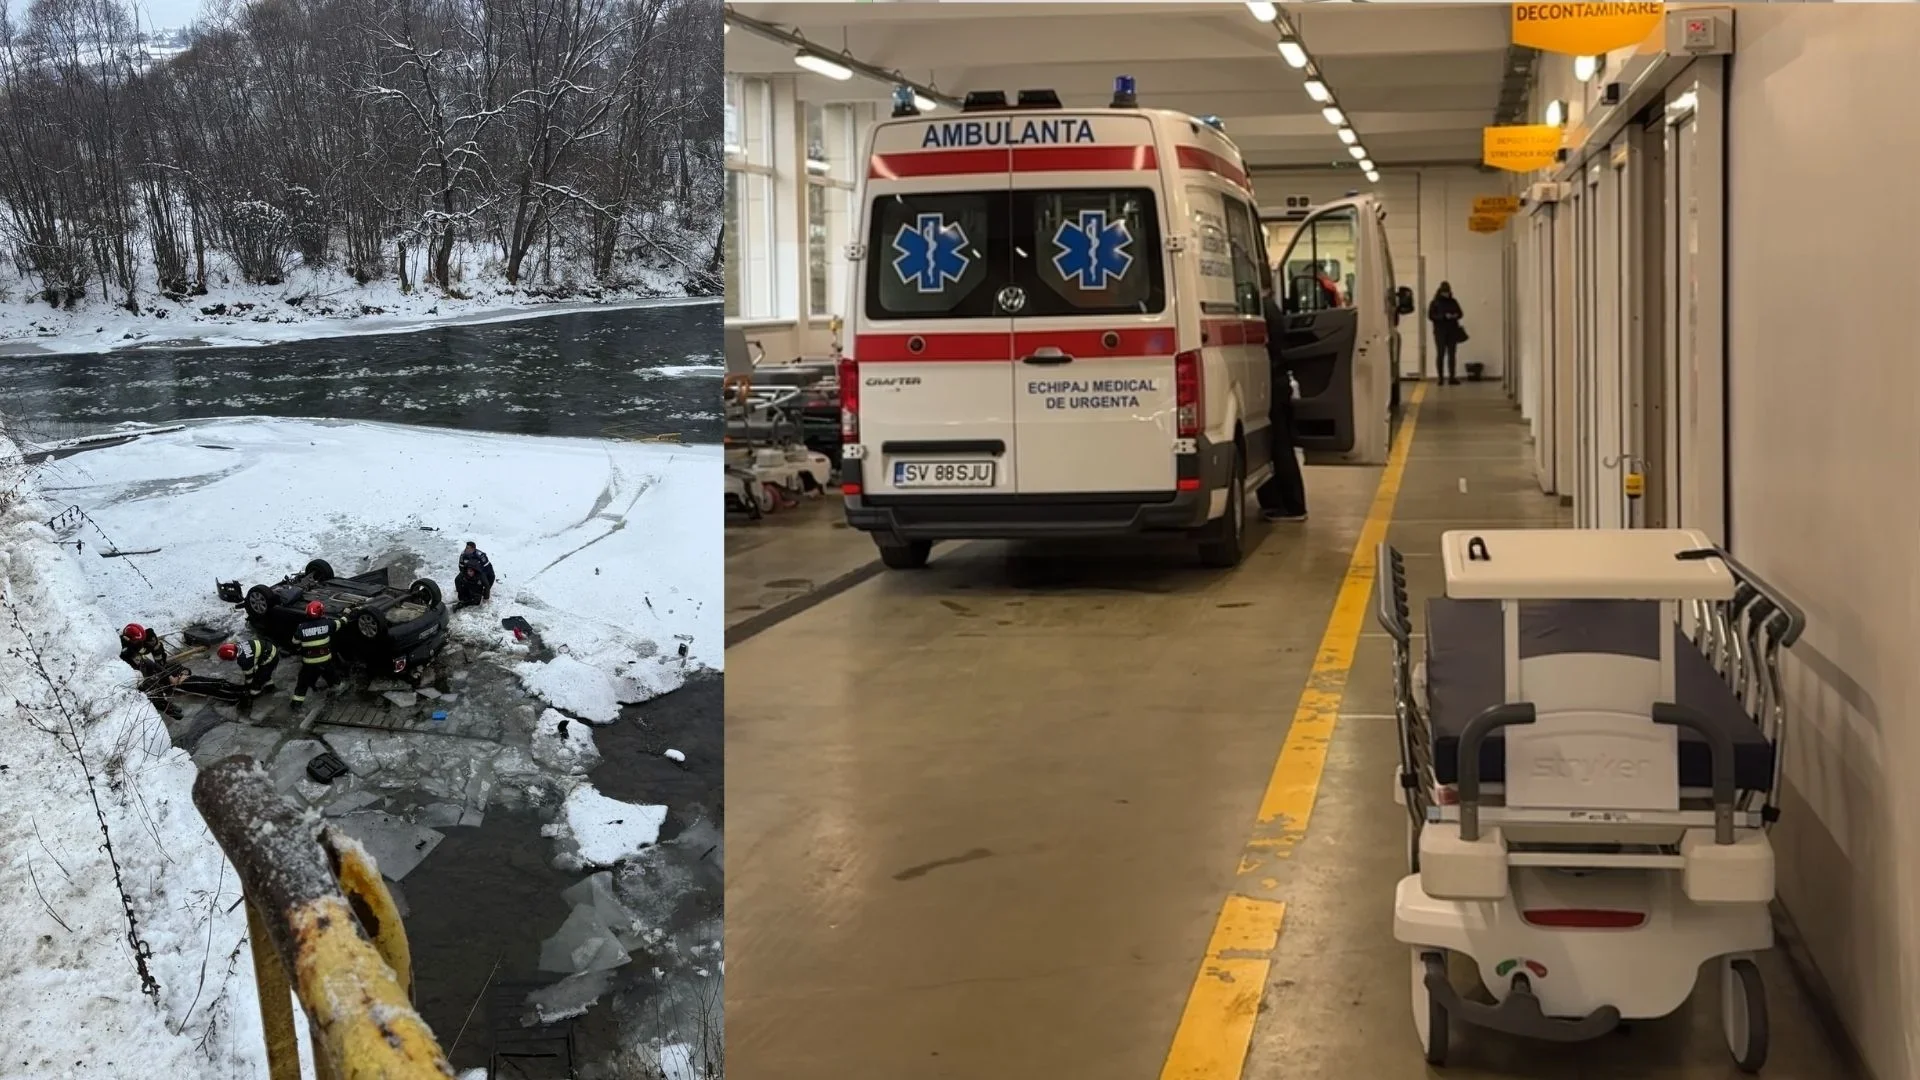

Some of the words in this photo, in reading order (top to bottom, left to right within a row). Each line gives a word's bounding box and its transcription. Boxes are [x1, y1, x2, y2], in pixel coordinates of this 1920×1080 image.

[1517, 2, 1659, 21] DECONTAMINARE
[922, 120, 1095, 147] AMBULANTA
[865, 377, 922, 386] CRAFTER
[1028, 381, 1089, 394] ECHIPAJ
[1092, 379, 1157, 392] MEDICAL
[1046, 397, 1066, 409] DE
[1069, 396, 1140, 408] URGENTA
[905, 465, 929, 481] SV
[1531, 752, 1651, 785] stryker
